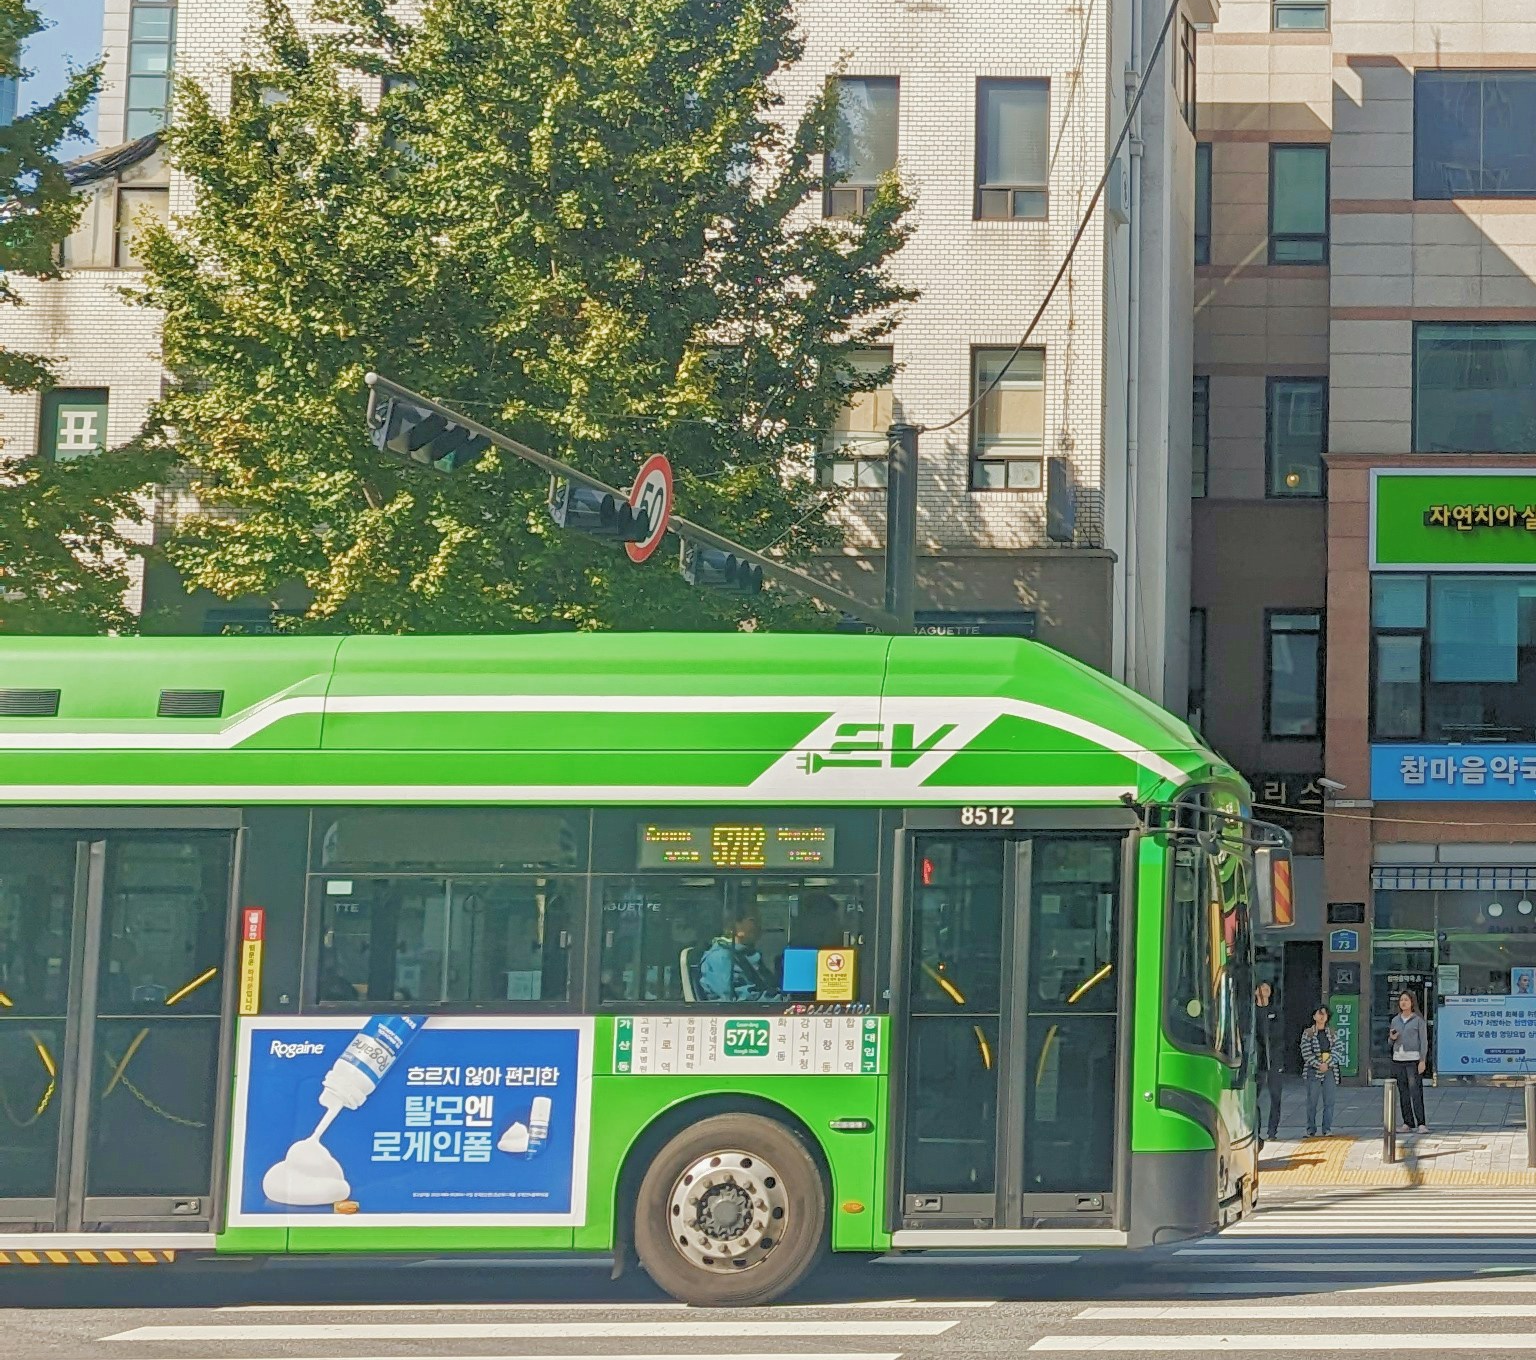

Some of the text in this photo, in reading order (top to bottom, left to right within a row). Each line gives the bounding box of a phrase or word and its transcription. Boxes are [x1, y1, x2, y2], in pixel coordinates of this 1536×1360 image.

[1429, 502, 1517, 532] 자연치아
[812, 723, 960, 772] EV
[961, 806, 1015, 826] 8512
[1338, 940, 1350, 949] 73
[269, 1039, 326, 1058] Rogaine
[660, 1018, 673, 1073] 구로역
[726, 1028, 768, 1047] 5712
[776, 1018, 788, 1062] 화곡동
[798, 1018, 810, 1070] 강서구청
[821, 1018, 833, 1073] 염창동
[843, 1018, 855, 1073] 합정역
[863, 1019, 877, 1072] 홍대입구
[406, 1066, 560, 1087] 흐르지 않아 편리한
[404, 1095, 494, 1127] 탈모엔
[370, 1131, 494, 1163] 로게인폼
